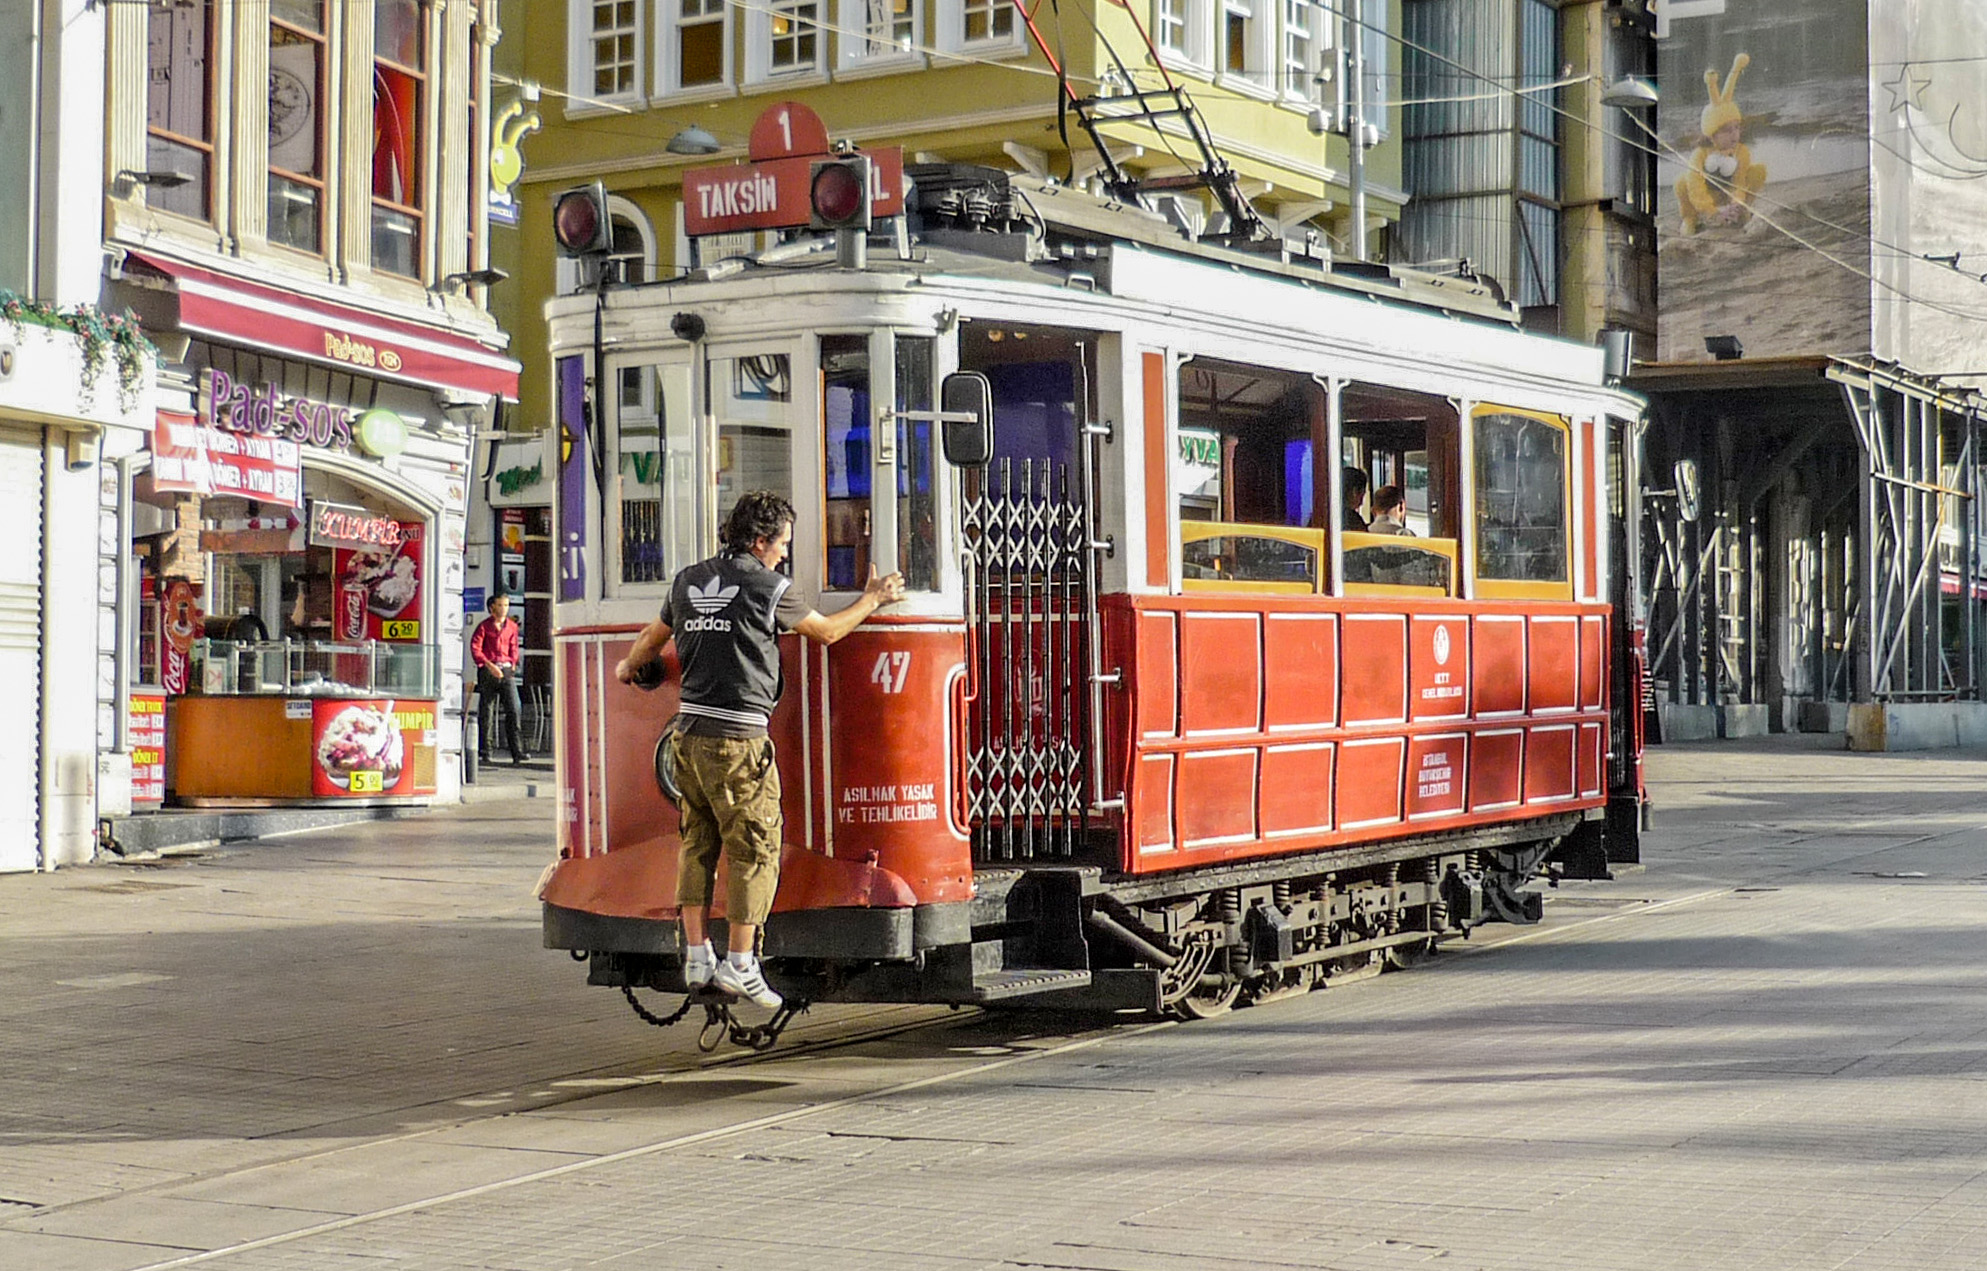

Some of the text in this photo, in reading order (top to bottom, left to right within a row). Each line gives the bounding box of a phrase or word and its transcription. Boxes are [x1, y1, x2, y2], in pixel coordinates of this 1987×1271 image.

[778, 109, 793, 152] 1
[697, 171, 778, 219] TAKSİM
[210, 368, 351, 449] Pad-sos
[684, 615, 732, 632] adidas
[871, 651, 911, 694] 47
[355, 773, 364, 790] 5
[843, 783, 935, 804] ASILMAK YASAK
[838, 806, 855, 824] VE
